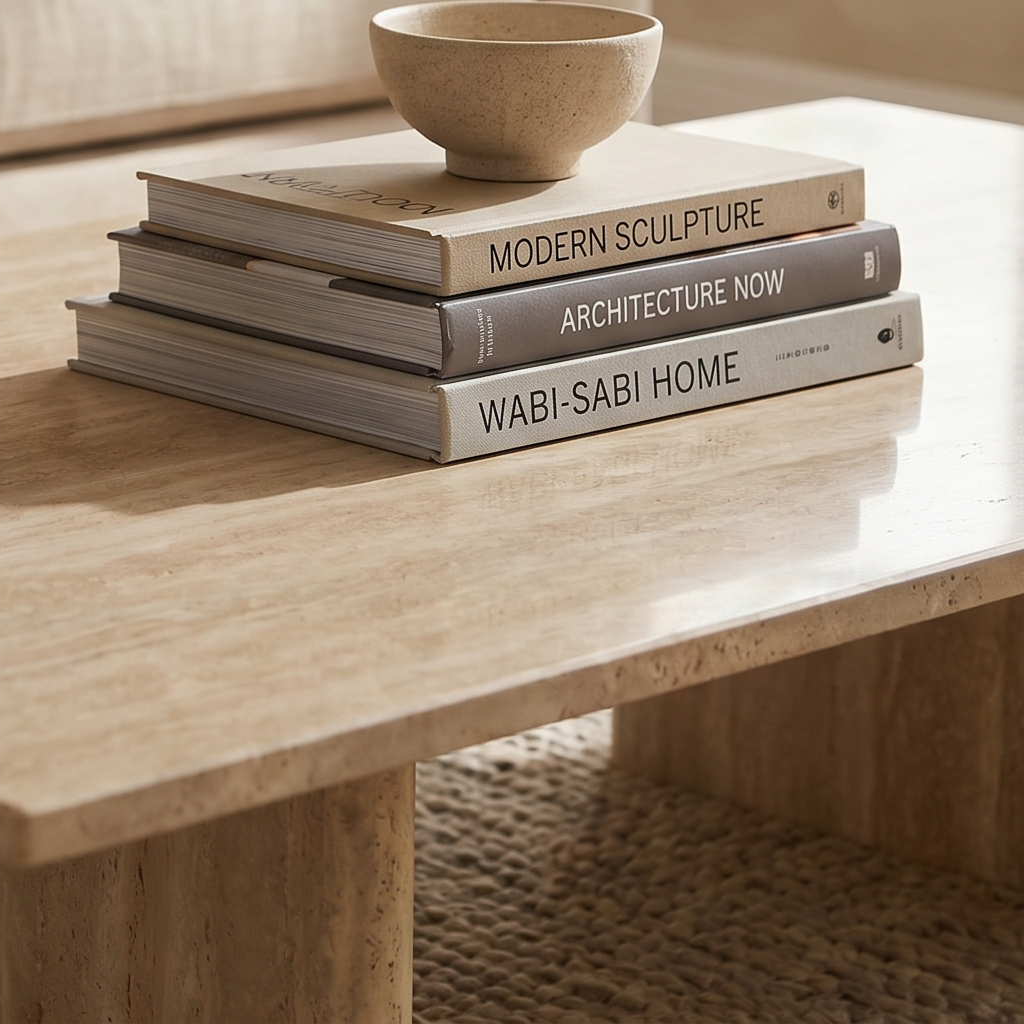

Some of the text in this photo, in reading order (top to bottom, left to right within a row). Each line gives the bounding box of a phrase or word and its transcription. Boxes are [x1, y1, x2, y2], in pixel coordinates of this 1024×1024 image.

[489, 198, 765, 274] MODERN SCULPTURE
[560, 268, 785, 335] ARCHITECTURE NOW
[479, 350, 741, 434] WABI-SABI HOME
